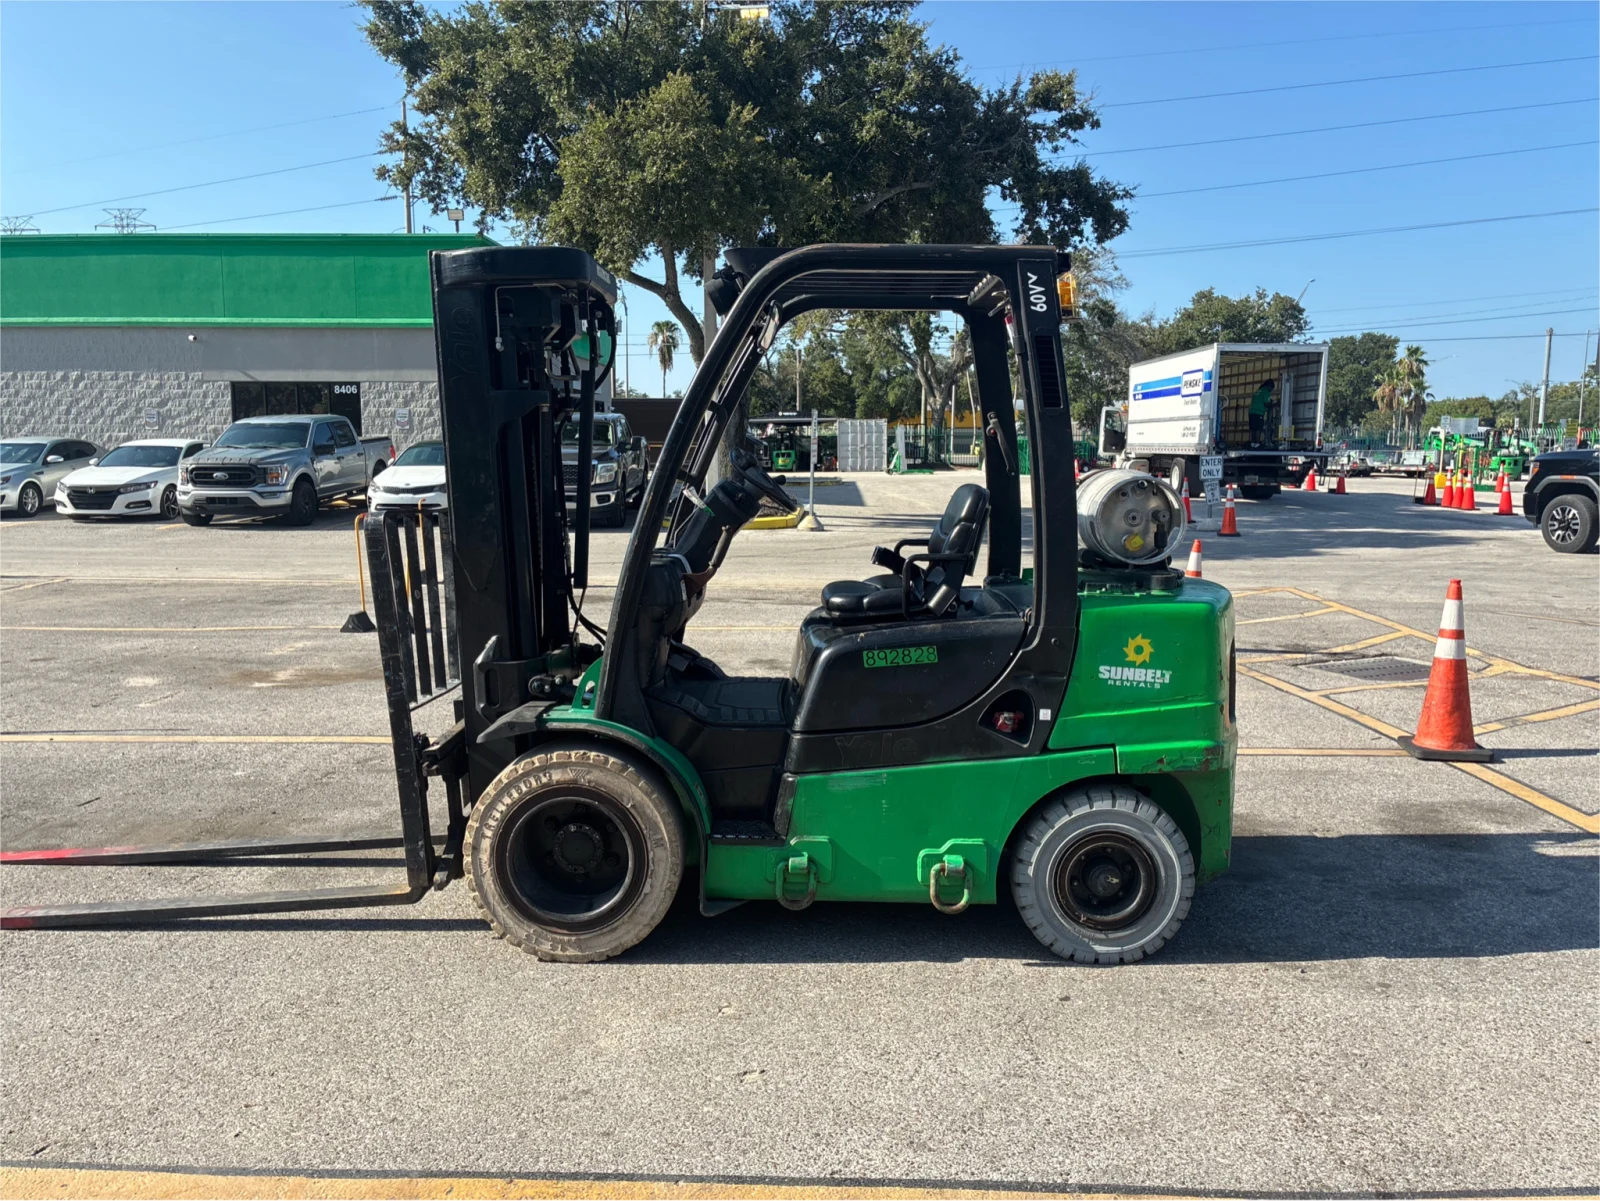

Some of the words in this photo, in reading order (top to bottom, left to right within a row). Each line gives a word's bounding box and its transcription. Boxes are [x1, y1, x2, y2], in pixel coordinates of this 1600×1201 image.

[1183, 379, 1201, 389] PENSKE
[334, 385, 357, 394] 8406
[1201, 458, 1221, 466] ENTER
[1202, 469, 1220, 477] ONLY
[865, 646, 937, 666] 892828
[1098, 665, 1172, 684] SUNBELT
[1107, 680, 1160, 689] RENTALS
